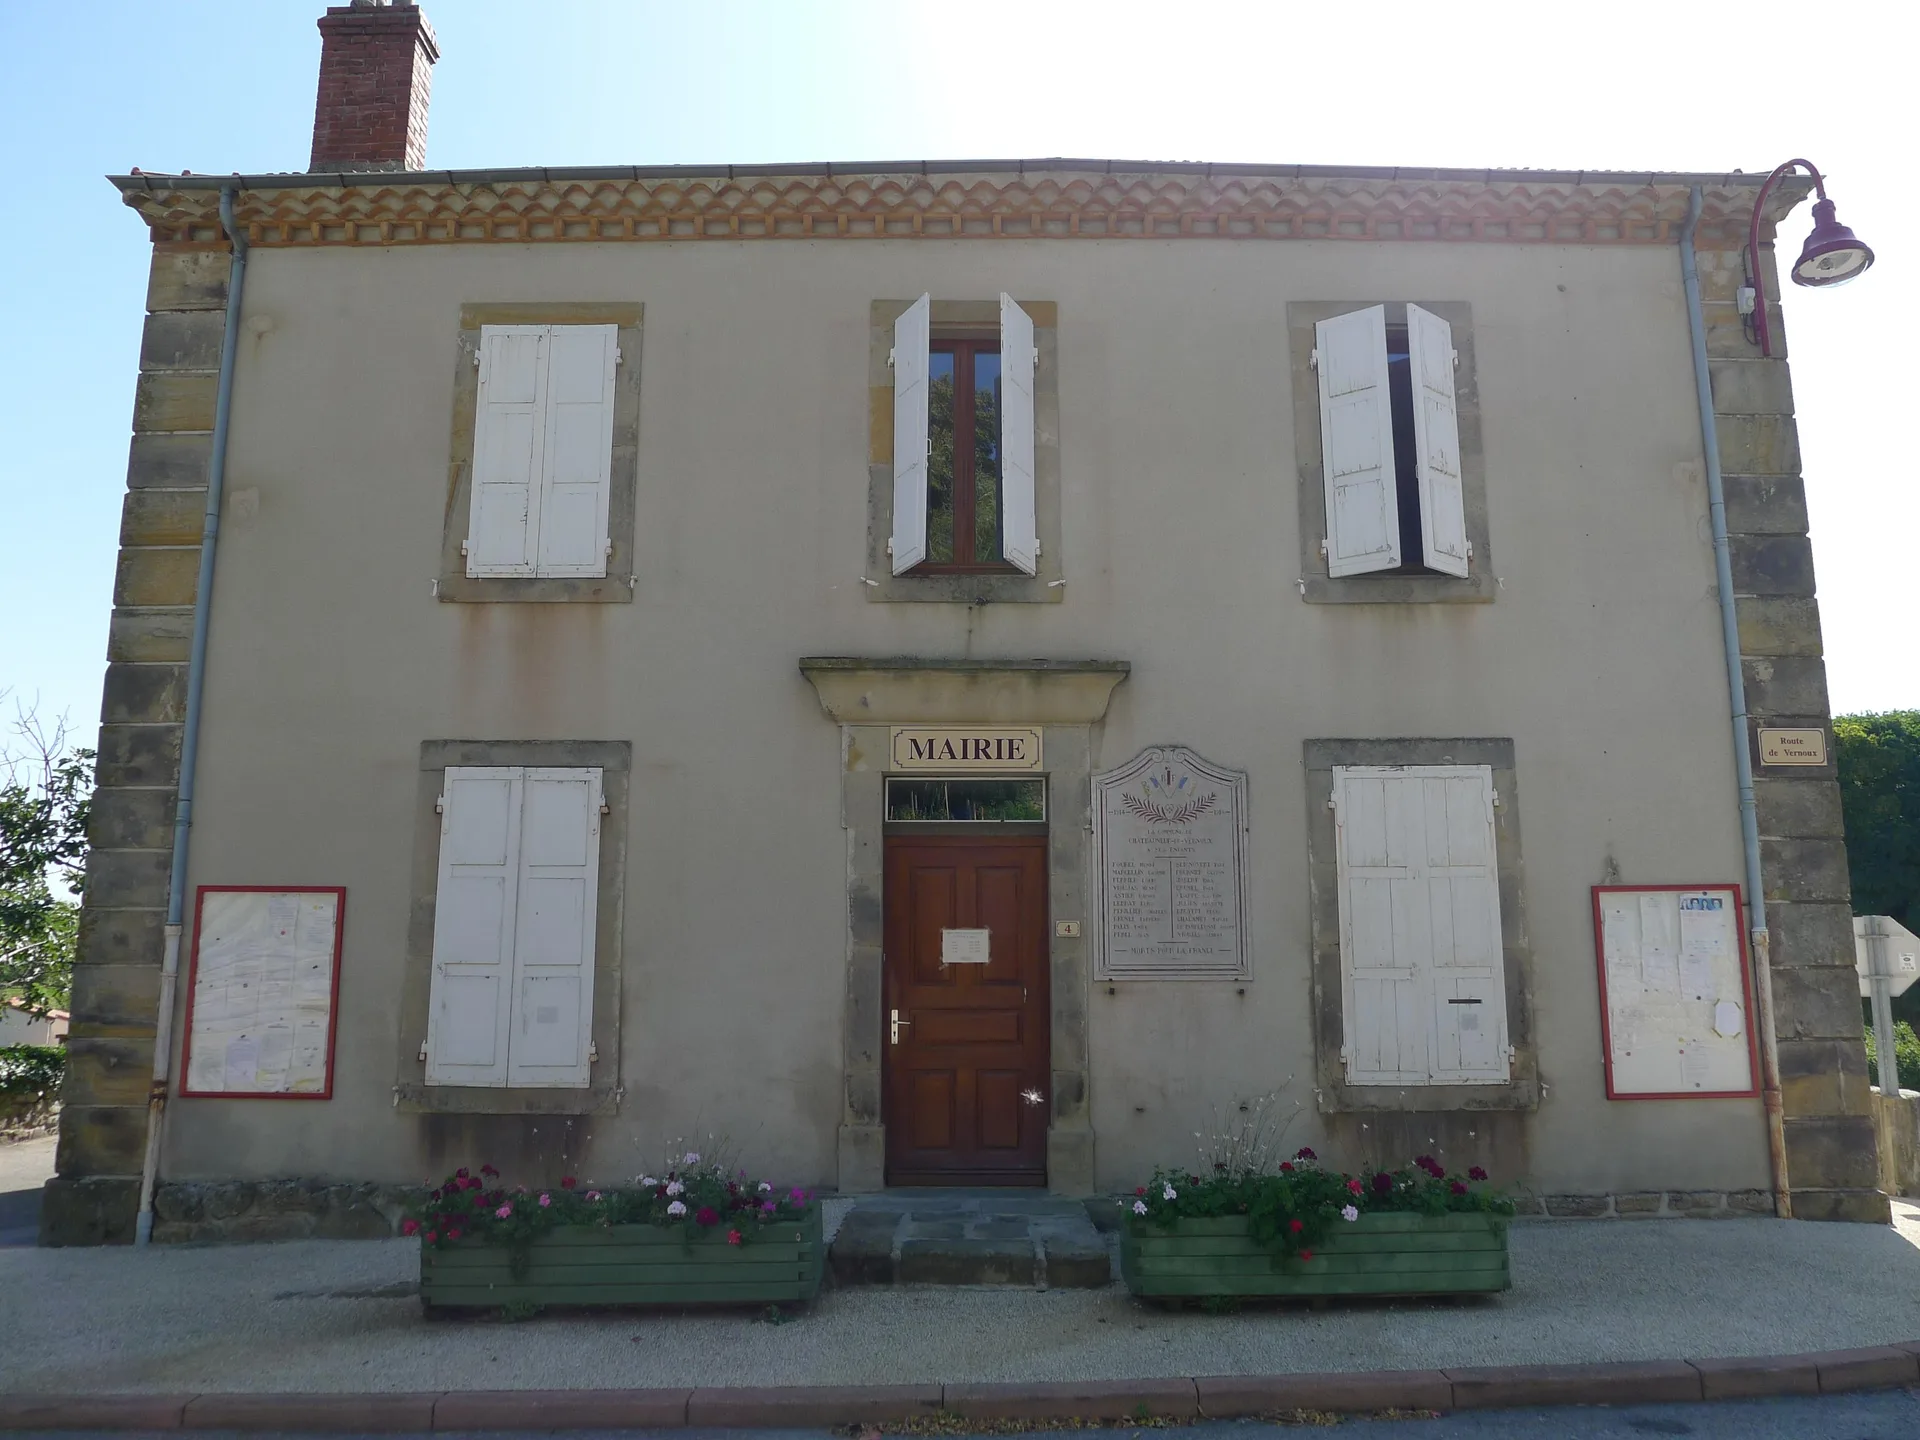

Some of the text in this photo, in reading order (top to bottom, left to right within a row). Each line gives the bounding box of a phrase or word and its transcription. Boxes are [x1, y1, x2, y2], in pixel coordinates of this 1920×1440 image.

[1780, 737, 1804, 745] Route
[908, 738, 1025, 760] MAIRIE
[1784, 749, 1817, 757] Vernoux
[1064, 924, 1072, 934] 4
